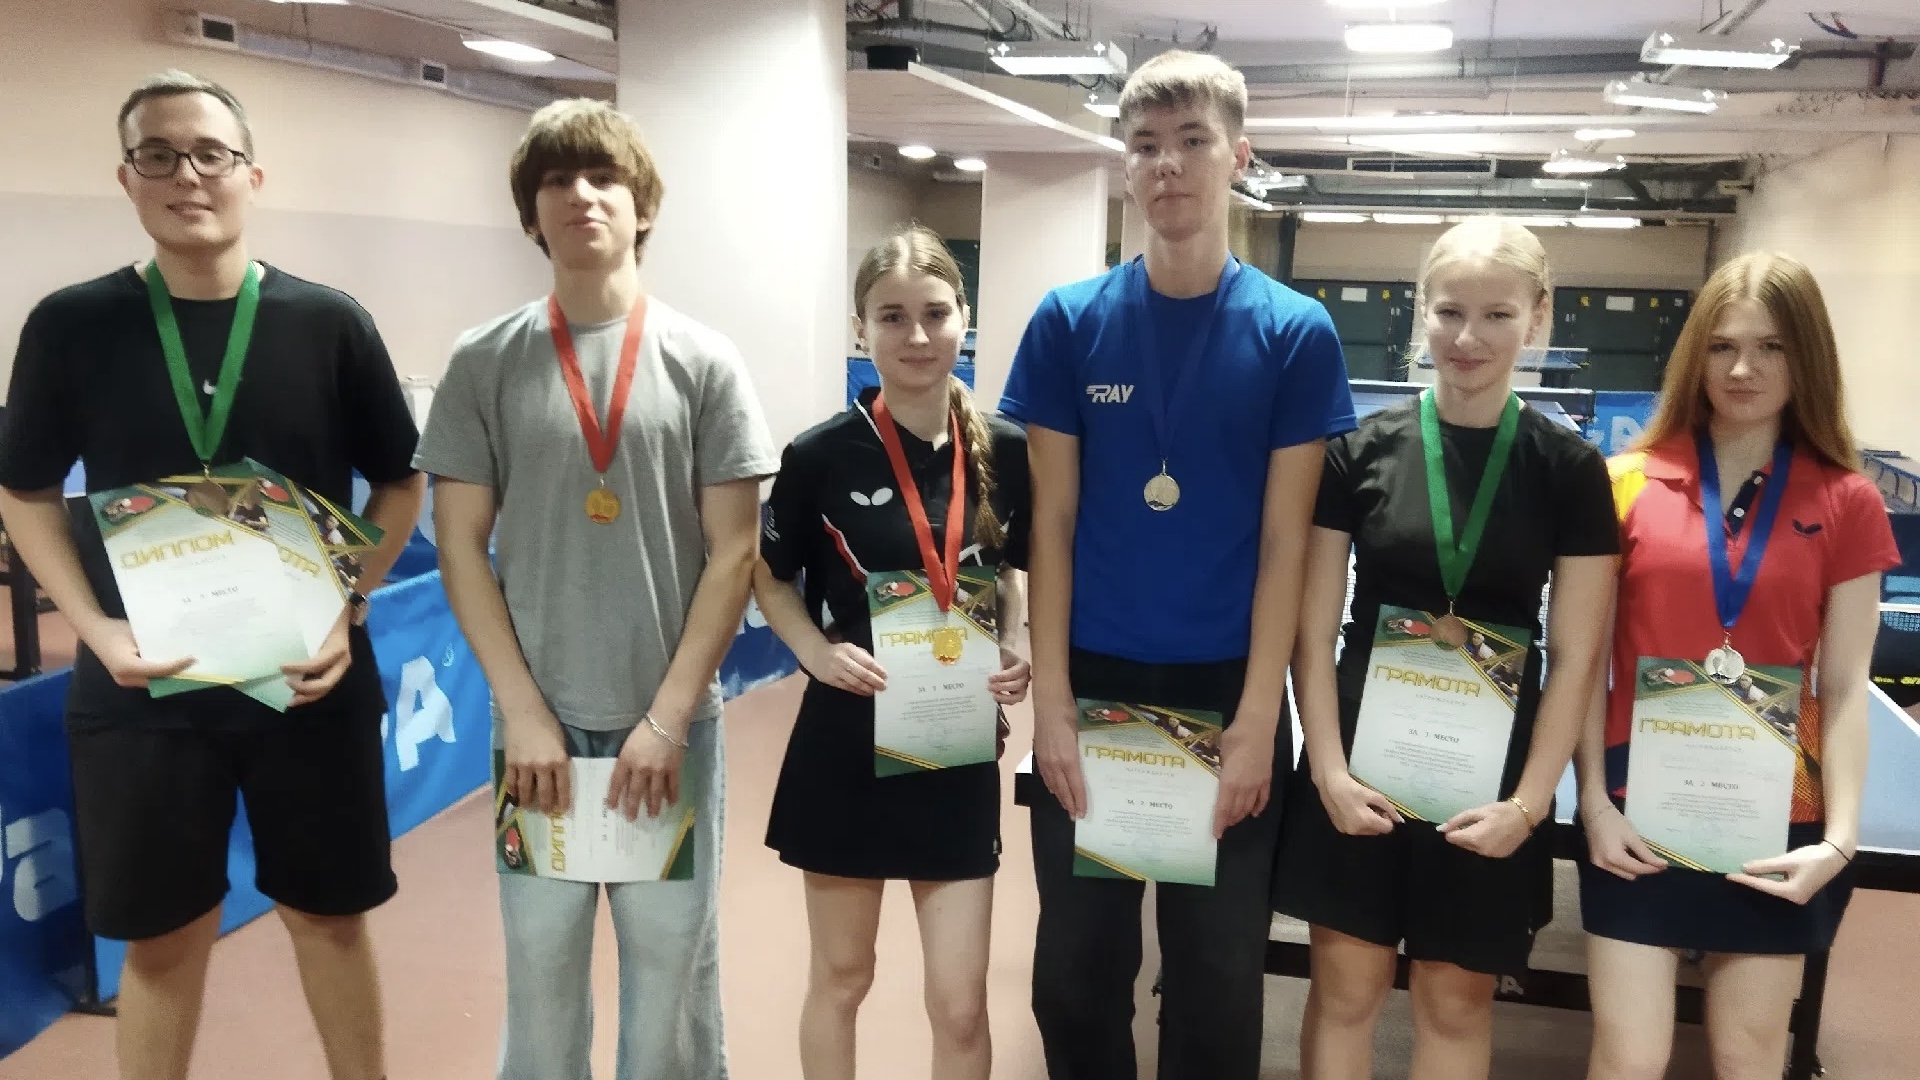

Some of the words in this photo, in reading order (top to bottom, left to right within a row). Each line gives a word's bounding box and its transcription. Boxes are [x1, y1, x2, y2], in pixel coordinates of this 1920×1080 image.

[1086, 384, 1134, 403] RAY
[120, 531, 234, 569] ДИПЛОМ
[879, 626, 969, 648] ГРАМА
[1374, 663, 1481, 698] ГРАМОТА
[1434, 732, 1460, 744] МЕСТО
[1639, 717, 1756, 742] ГРАМОТА
[1085, 744, 1186, 769] ГРАМОТА
